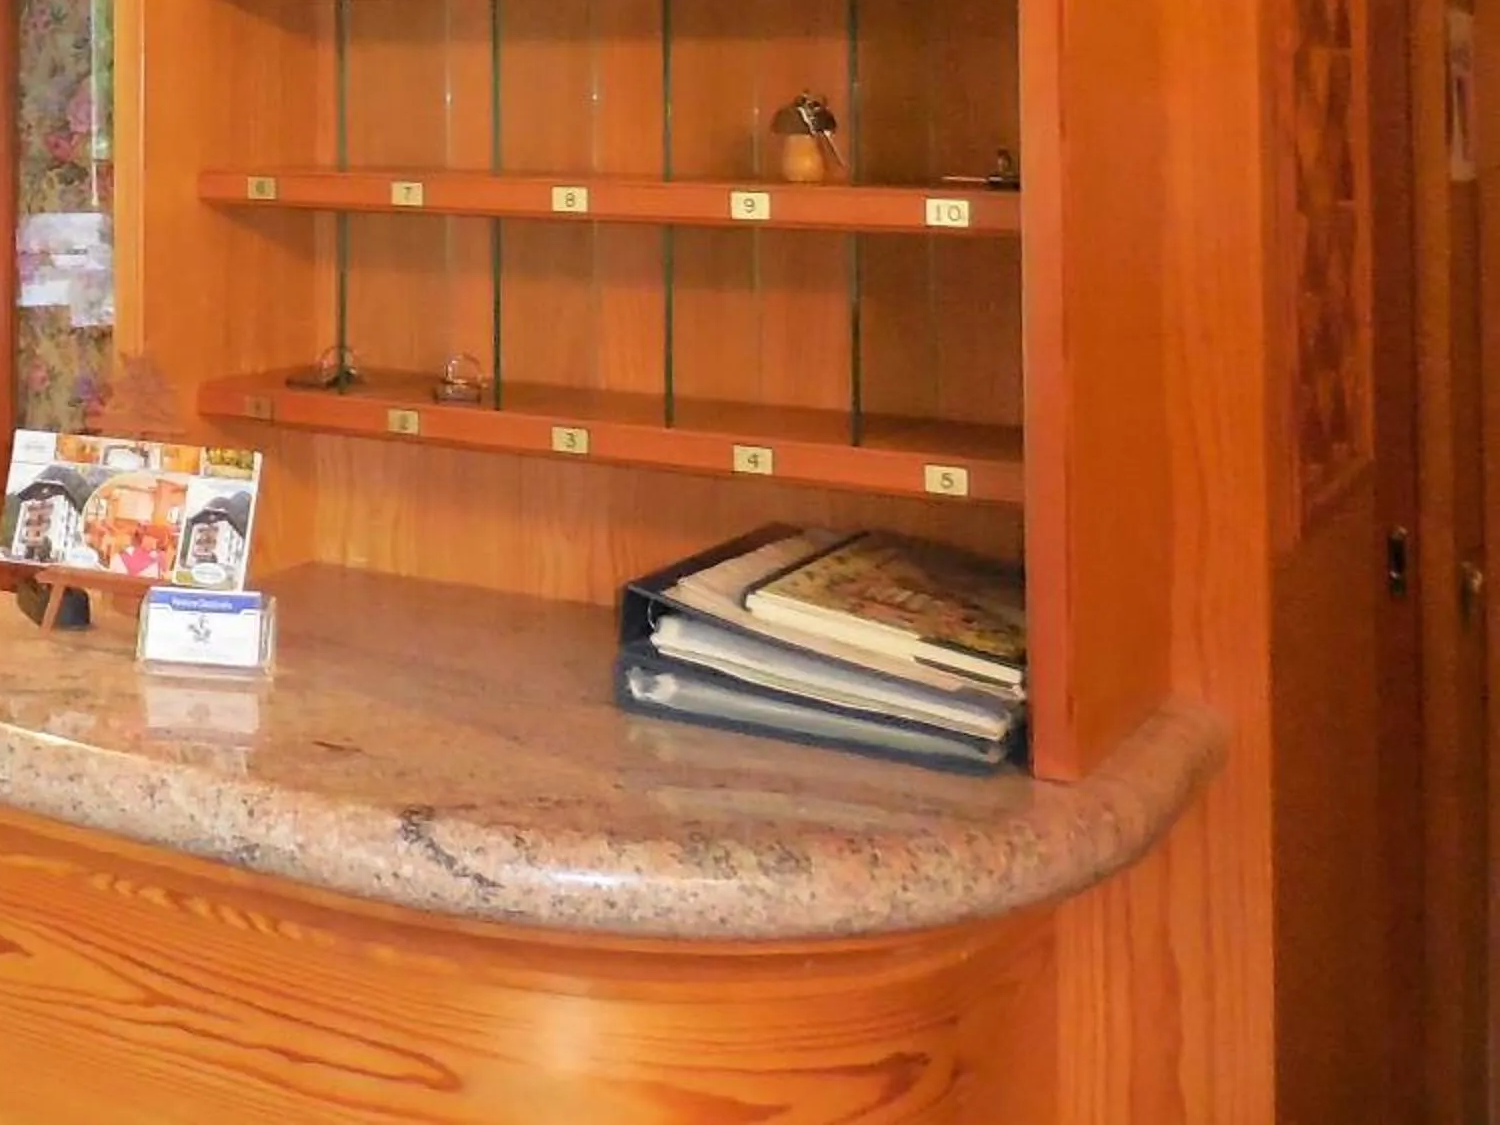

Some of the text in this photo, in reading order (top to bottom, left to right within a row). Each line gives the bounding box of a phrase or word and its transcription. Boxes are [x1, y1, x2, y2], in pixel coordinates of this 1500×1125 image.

[565, 193, 577, 208] 8
[743, 199, 756, 214] 9
[935, 205, 961, 222] 10
[565, 433, 577, 448] 3
[747, 453, 760, 469] 4
[941, 473, 955, 489] 5
